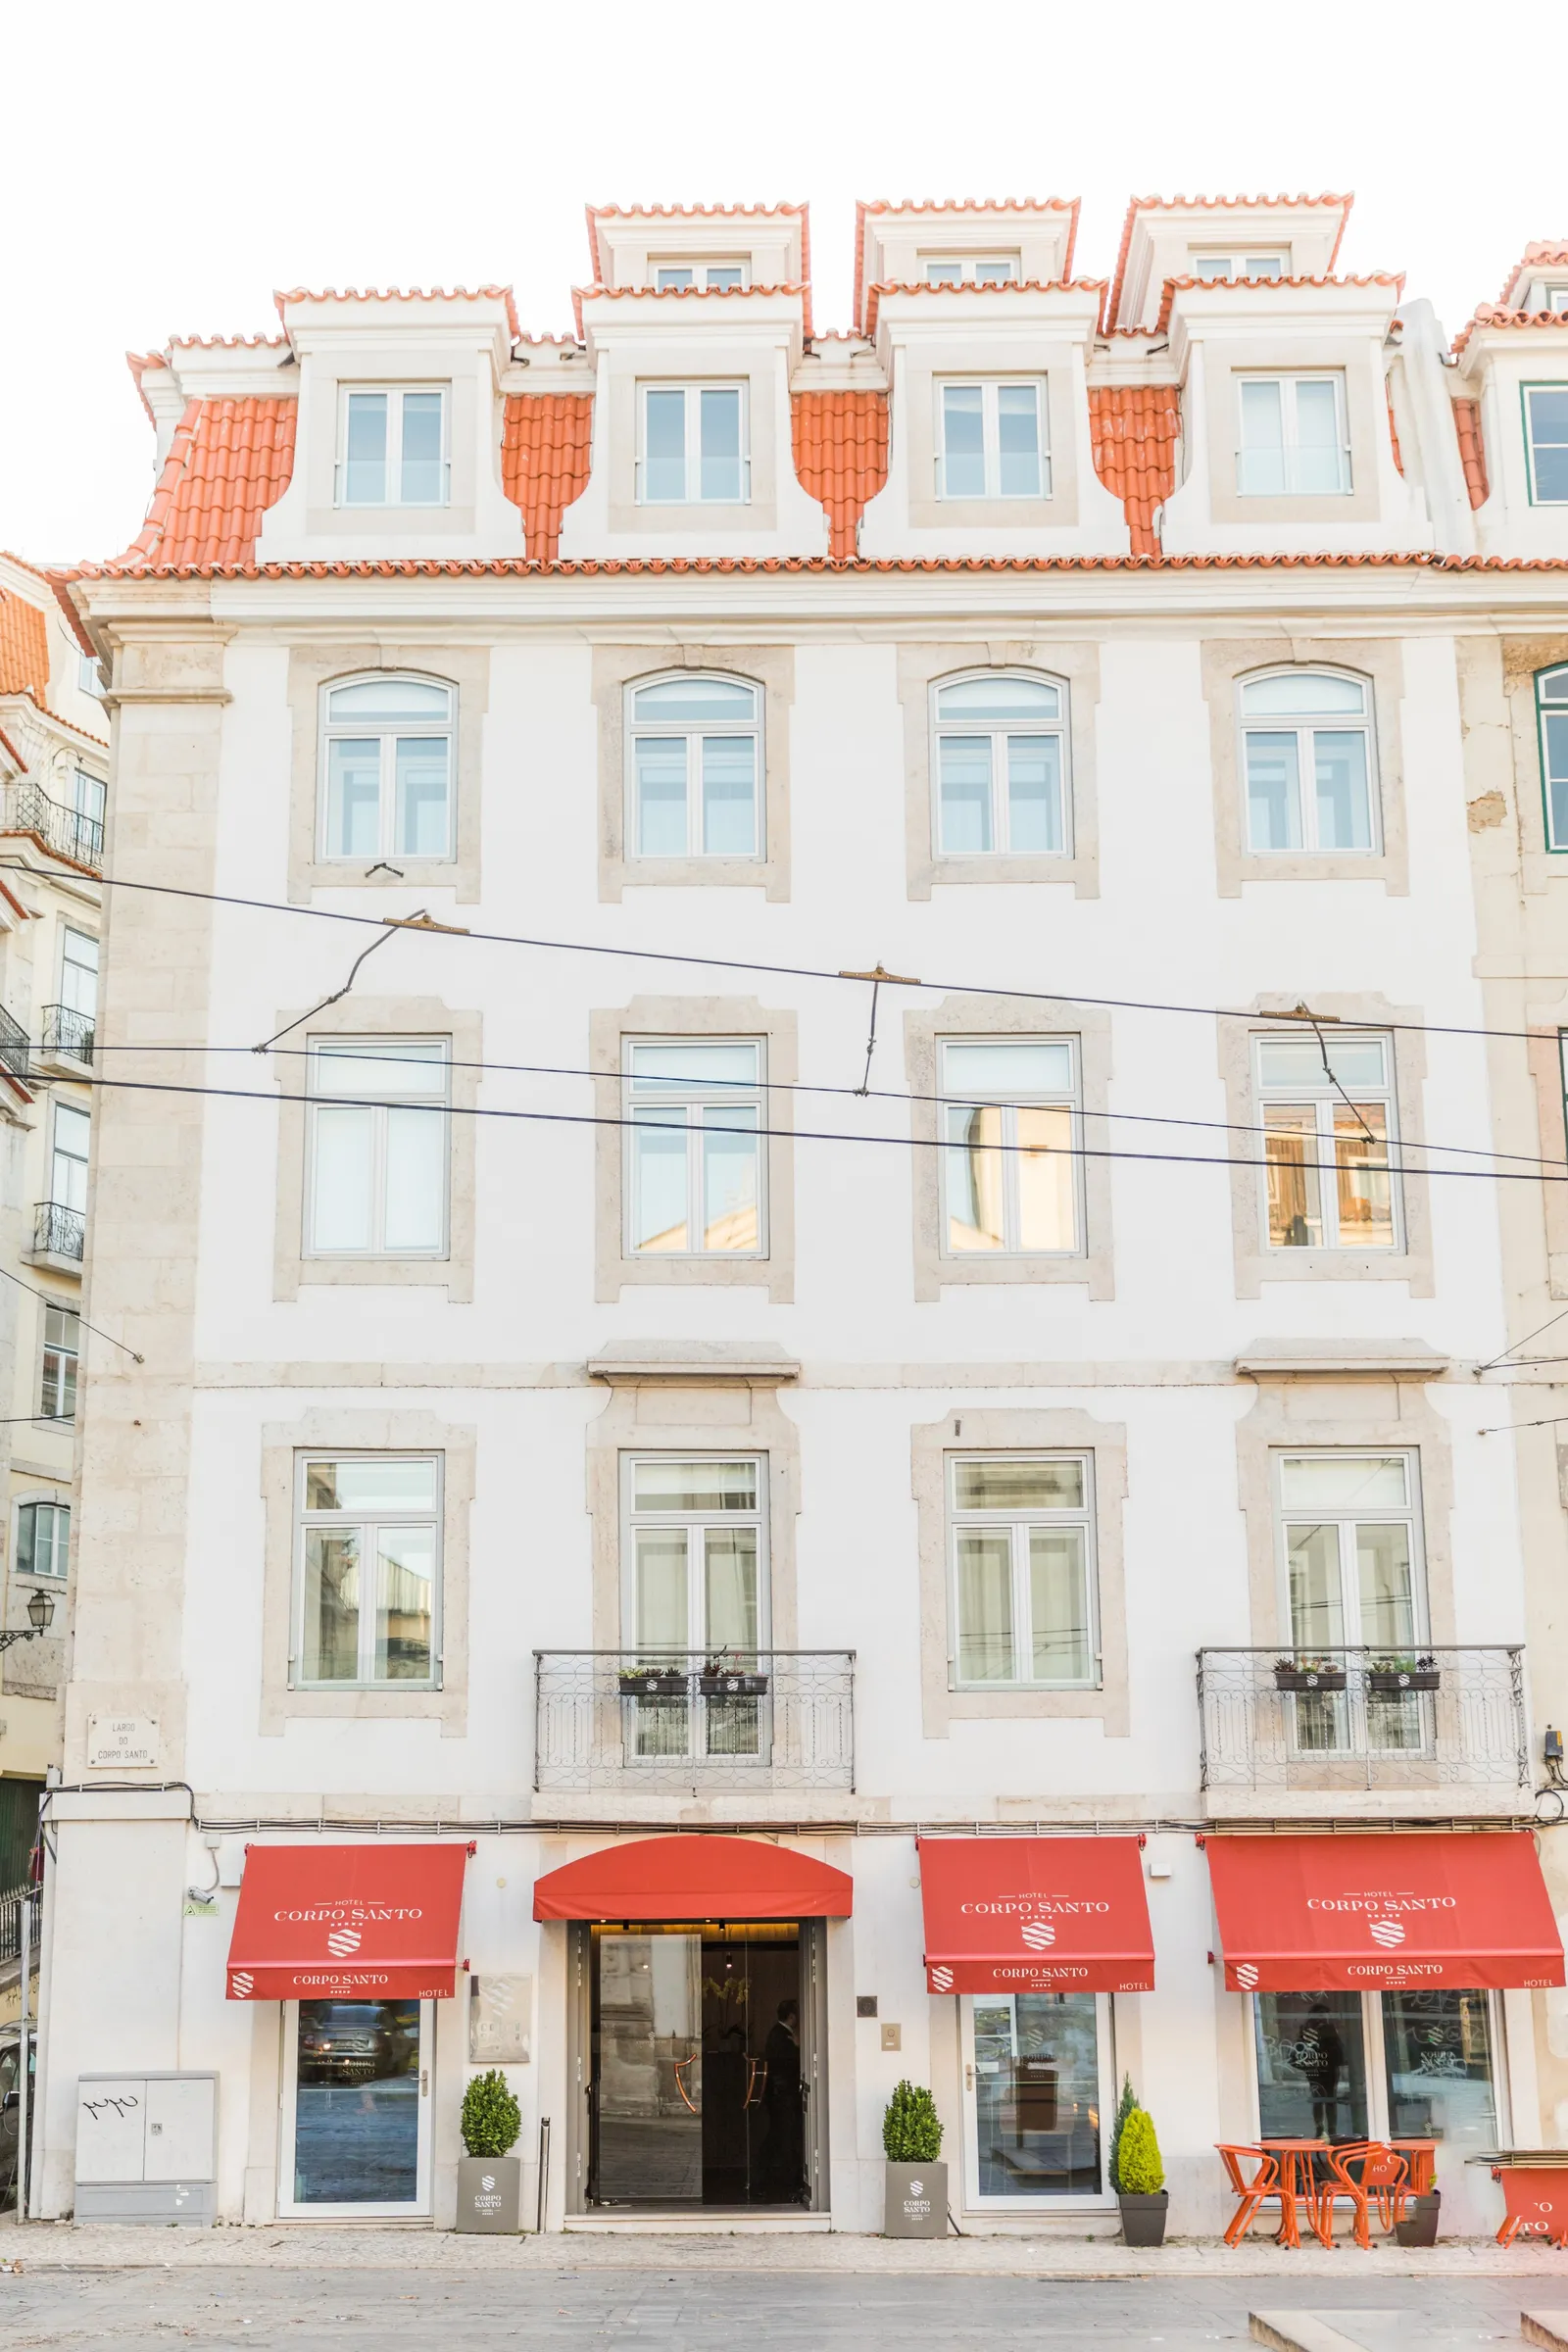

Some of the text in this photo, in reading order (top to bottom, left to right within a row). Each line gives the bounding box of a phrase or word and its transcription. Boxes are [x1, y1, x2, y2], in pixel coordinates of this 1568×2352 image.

[112, 1723, 135, 1732] LARGO
[98, 1749, 148, 1759] CORPO SANTO
[960, 1901, 1109, 1914] CORPO SANTO
[1306, 1896, 1456, 1911] CORPO SANTO
[273, 1908, 422, 1921] CORPO SANTO
[993, 1967, 1088, 1978] CORPO SANTO
[1347, 1964, 1443, 1976] CORPO SANTO
[293, 1974, 388, 1984] CORPO SANTO
[1523, 1979, 1554, 1987] HOTEL
[1119, 1982, 1150, 1990] HOTEL
[418, 1988, 449, 1997] HOTEL
